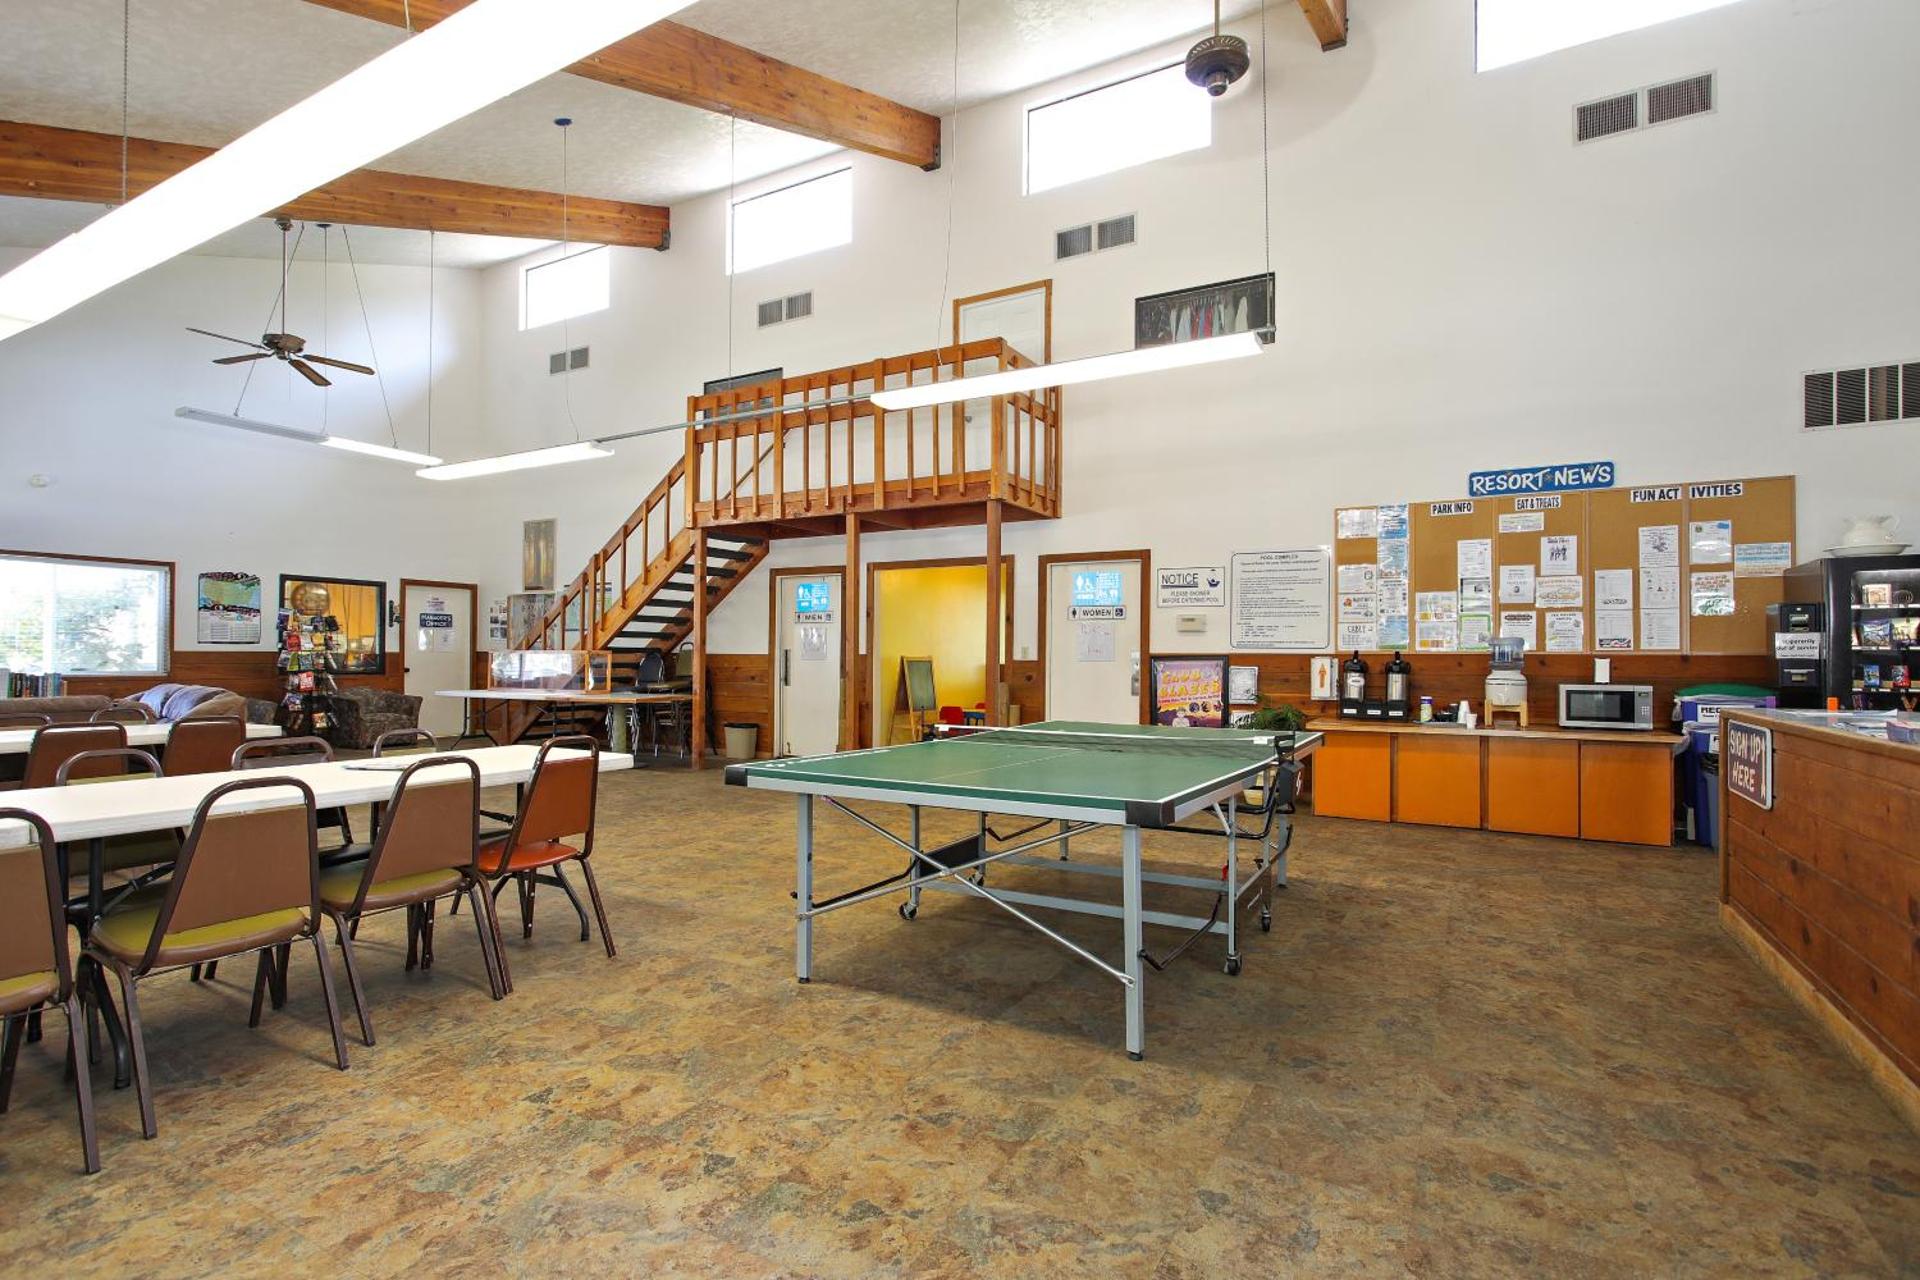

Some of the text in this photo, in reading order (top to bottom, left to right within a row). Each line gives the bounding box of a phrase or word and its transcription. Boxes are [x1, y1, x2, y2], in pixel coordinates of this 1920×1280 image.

[1472, 464, 1612, 494] RESORT NEWS
[1633, 484, 1741, 500] FUN ACT IVITIES
[1432, 503, 1472, 514] PARK INFO
[1517, 496, 1560, 510] EAT & TREATS
[1161, 573, 1199, 586] NOTICE
[1730, 729, 1761, 763] SIGN UP
[1732, 761, 1756, 792] HERE
